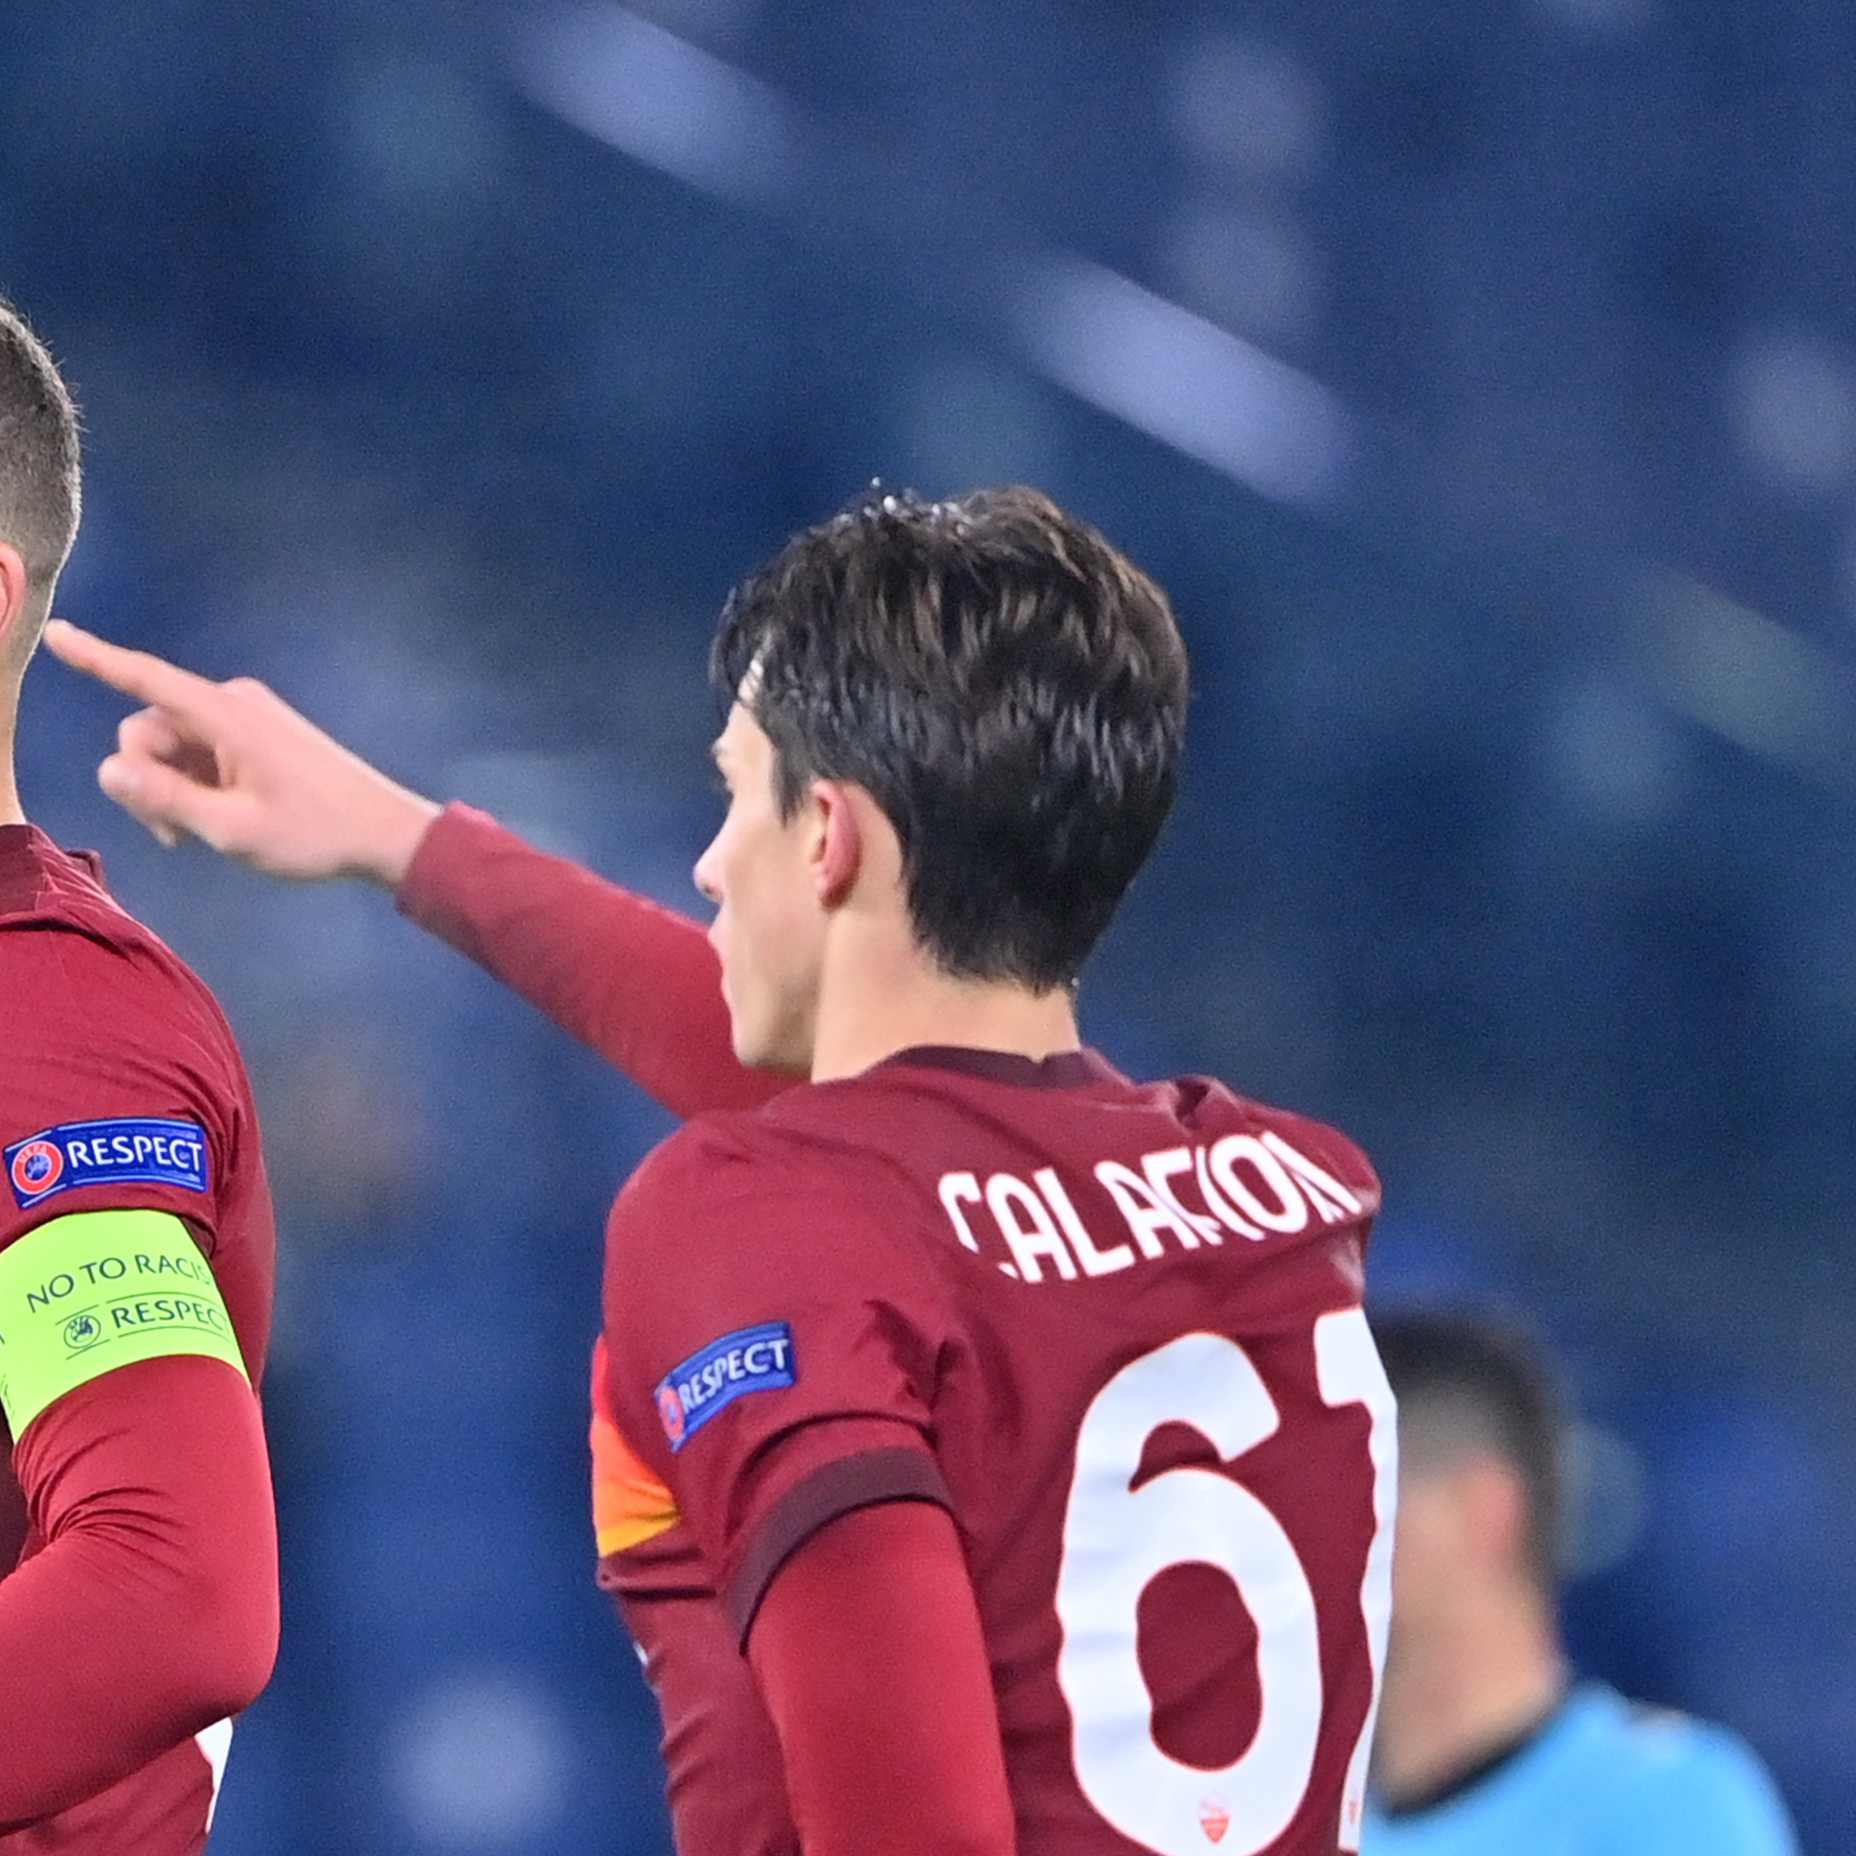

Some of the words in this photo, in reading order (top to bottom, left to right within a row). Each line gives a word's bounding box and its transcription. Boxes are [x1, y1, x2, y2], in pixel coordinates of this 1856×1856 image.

[66, 1136, 203, 1173] RESPECT
[26, 1273, 75, 1313] NO
[80, 1257, 127, 1285] TO
[111, 1300, 231, 1335] RESPEC
[678, 1339, 788, 1415] RESPECT
